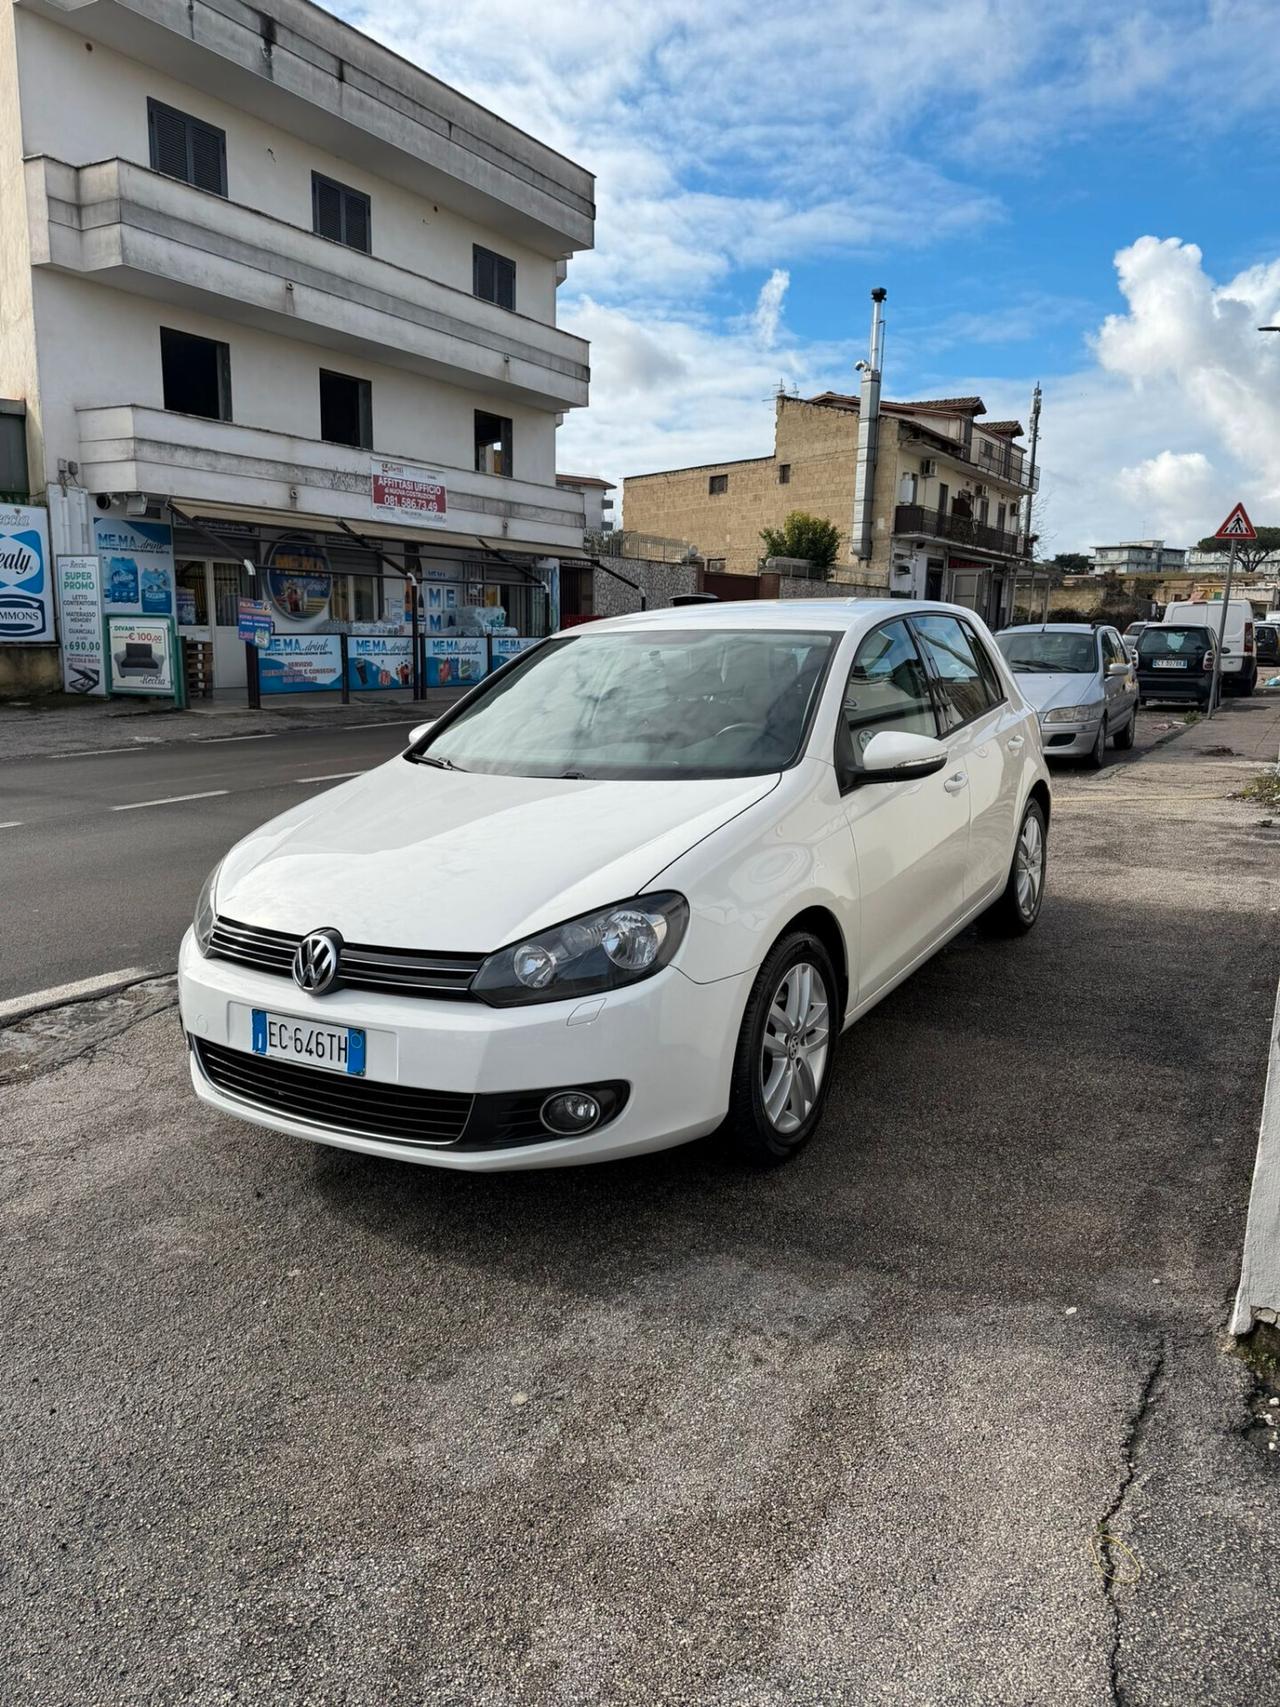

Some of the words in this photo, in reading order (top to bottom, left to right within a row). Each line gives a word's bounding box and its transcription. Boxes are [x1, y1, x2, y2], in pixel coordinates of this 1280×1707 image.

[378, 477, 413, 491] AFFITTASI
[414, 483, 441, 495] UFFICIO
[0, 547, 31, 575] ealy
[64, 571, 92, 580] SUPER
[63, 581, 95, 590] PROMO
